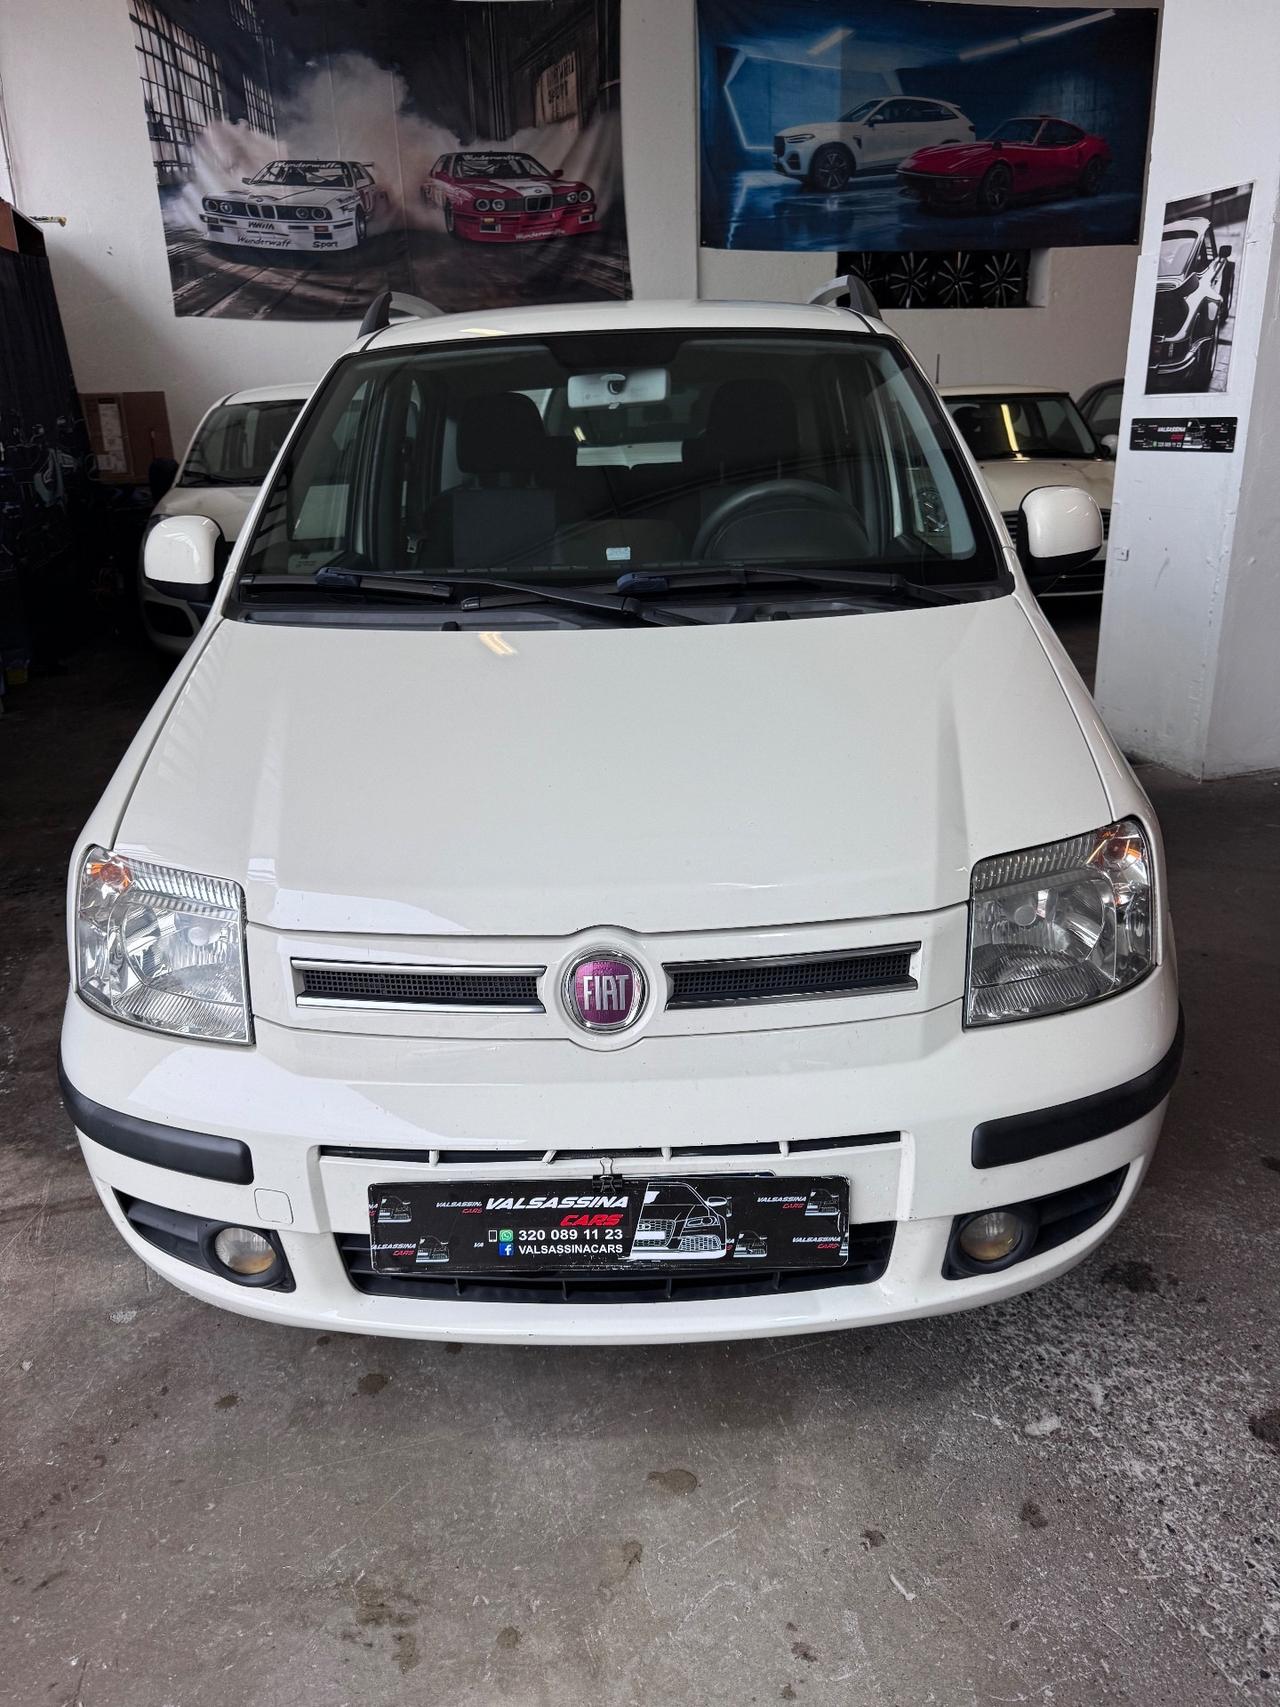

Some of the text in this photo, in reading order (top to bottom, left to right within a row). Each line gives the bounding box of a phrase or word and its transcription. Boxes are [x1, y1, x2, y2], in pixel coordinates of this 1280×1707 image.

[583, 975, 629, 1011] FIAT
[486, 1196, 629, 1210] VALSASSINA
[560, 1213, 624, 1227] CARS
[518, 1229, 623, 1241] 320 089 11 23
[518, 1244, 623, 1255] VALSASSINACARS
